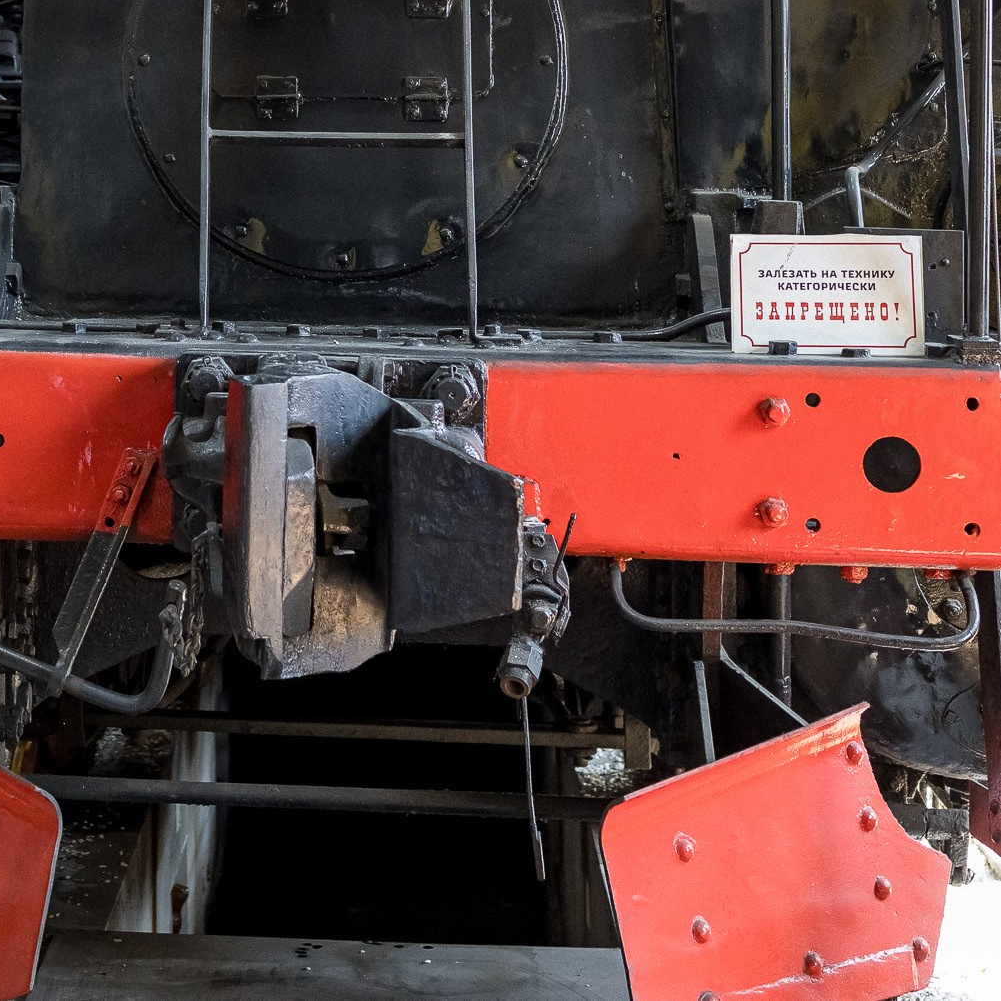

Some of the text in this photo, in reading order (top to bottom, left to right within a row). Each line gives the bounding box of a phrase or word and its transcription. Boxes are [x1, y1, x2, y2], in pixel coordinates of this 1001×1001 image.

[758, 269, 896, 279] ЗАЛЕЗАТЬ НА ТЕХНИКУ
[777, 282, 877, 292] КАТЕГОРИЧЕСКИ
[755, 301, 901, 324] ЗАПРЕЩЕНО!
